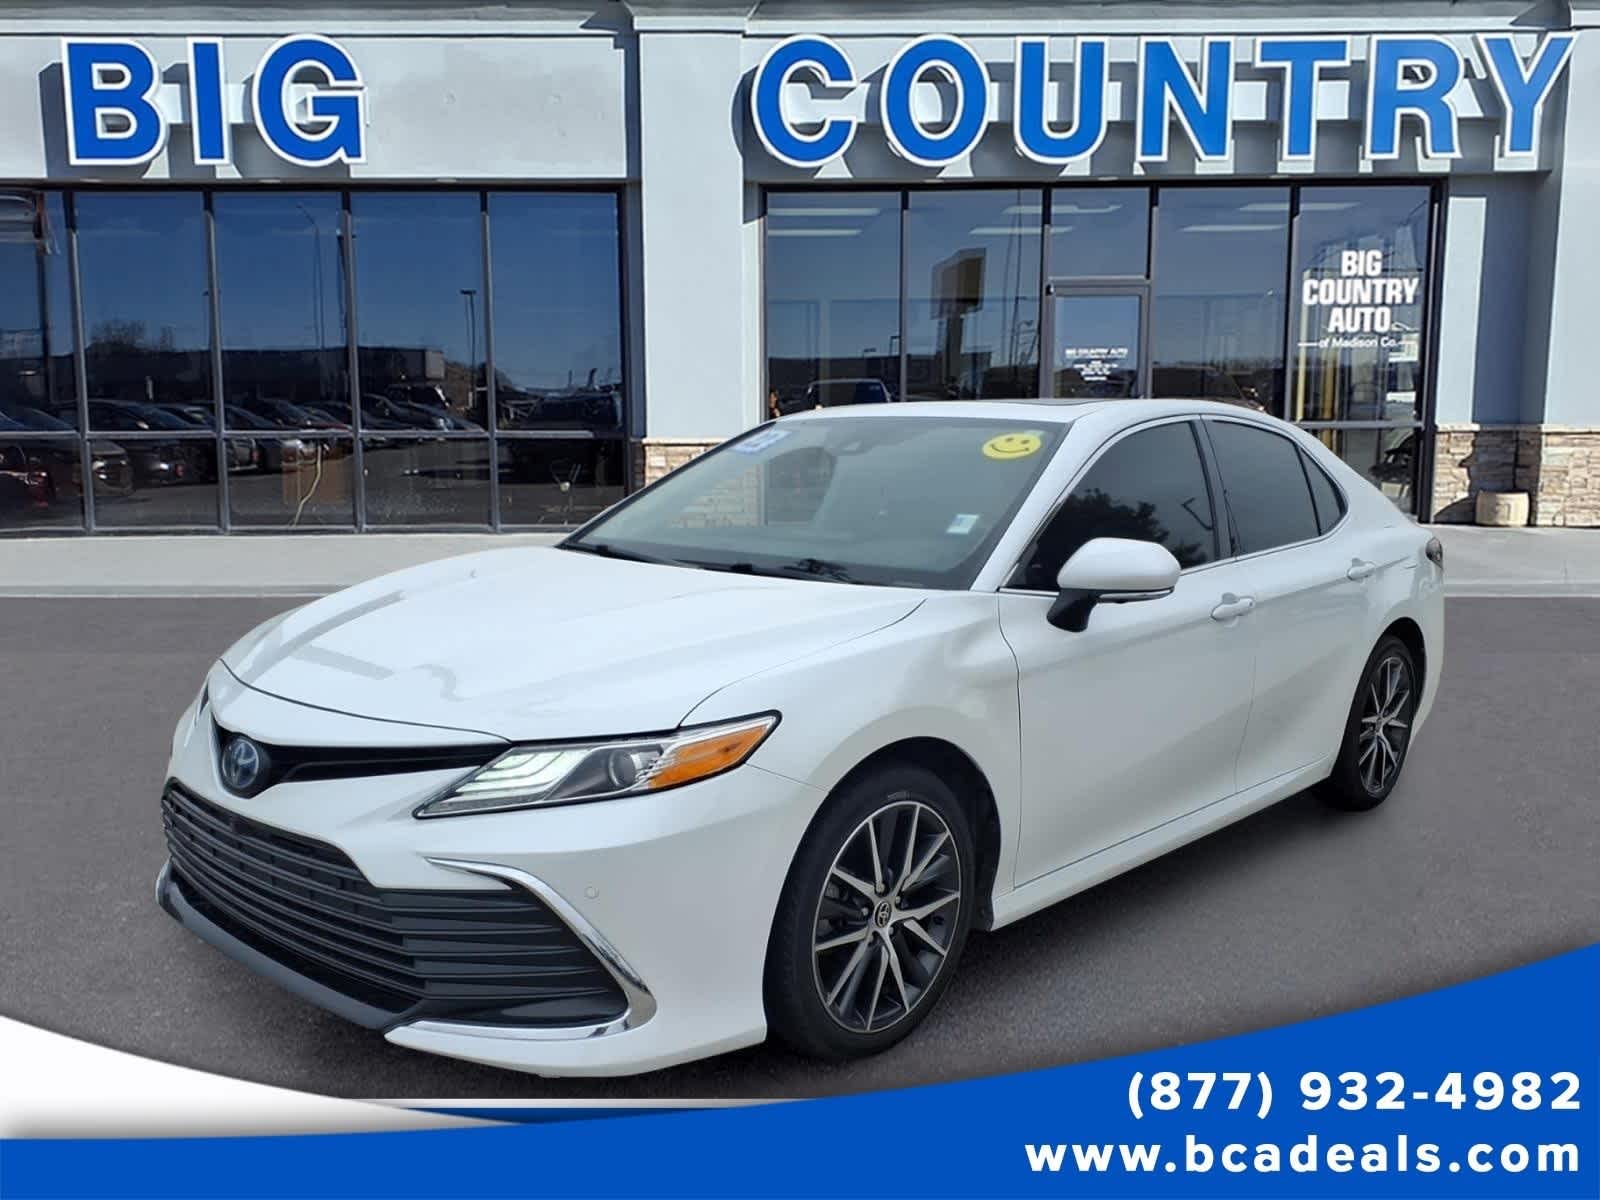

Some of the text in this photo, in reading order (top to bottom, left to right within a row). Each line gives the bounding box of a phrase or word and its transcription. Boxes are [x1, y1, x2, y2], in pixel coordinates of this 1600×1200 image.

[61, 31, 1579, 168] BIG COUNTRY
[1341, 249, 1382, 277] BIG
[1303, 277, 1419, 305] COUNTRY
[1328, 306, 1391, 333] AUTO
